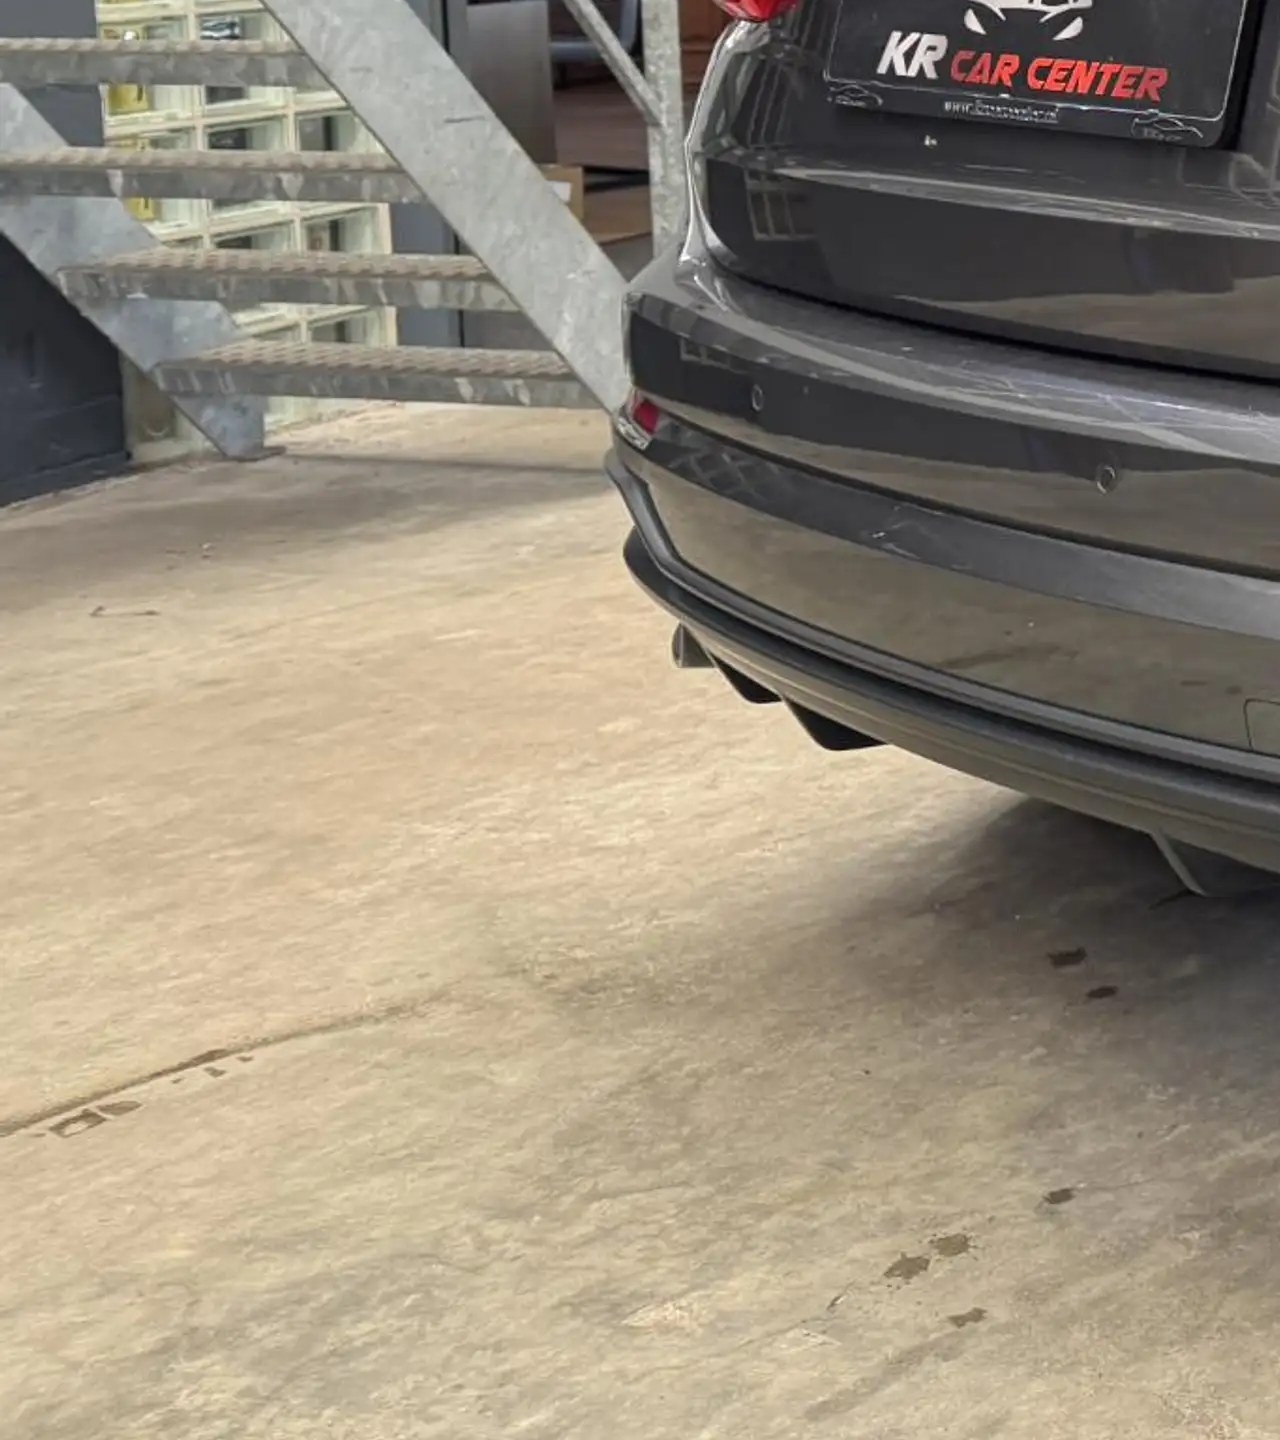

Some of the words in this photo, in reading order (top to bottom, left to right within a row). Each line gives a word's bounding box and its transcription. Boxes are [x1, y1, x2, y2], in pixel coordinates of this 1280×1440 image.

[876, 30, 948, 79] KR
[950, 49, 1019, 87] CAR
[1026, 57, 1169, 102] CENTER
